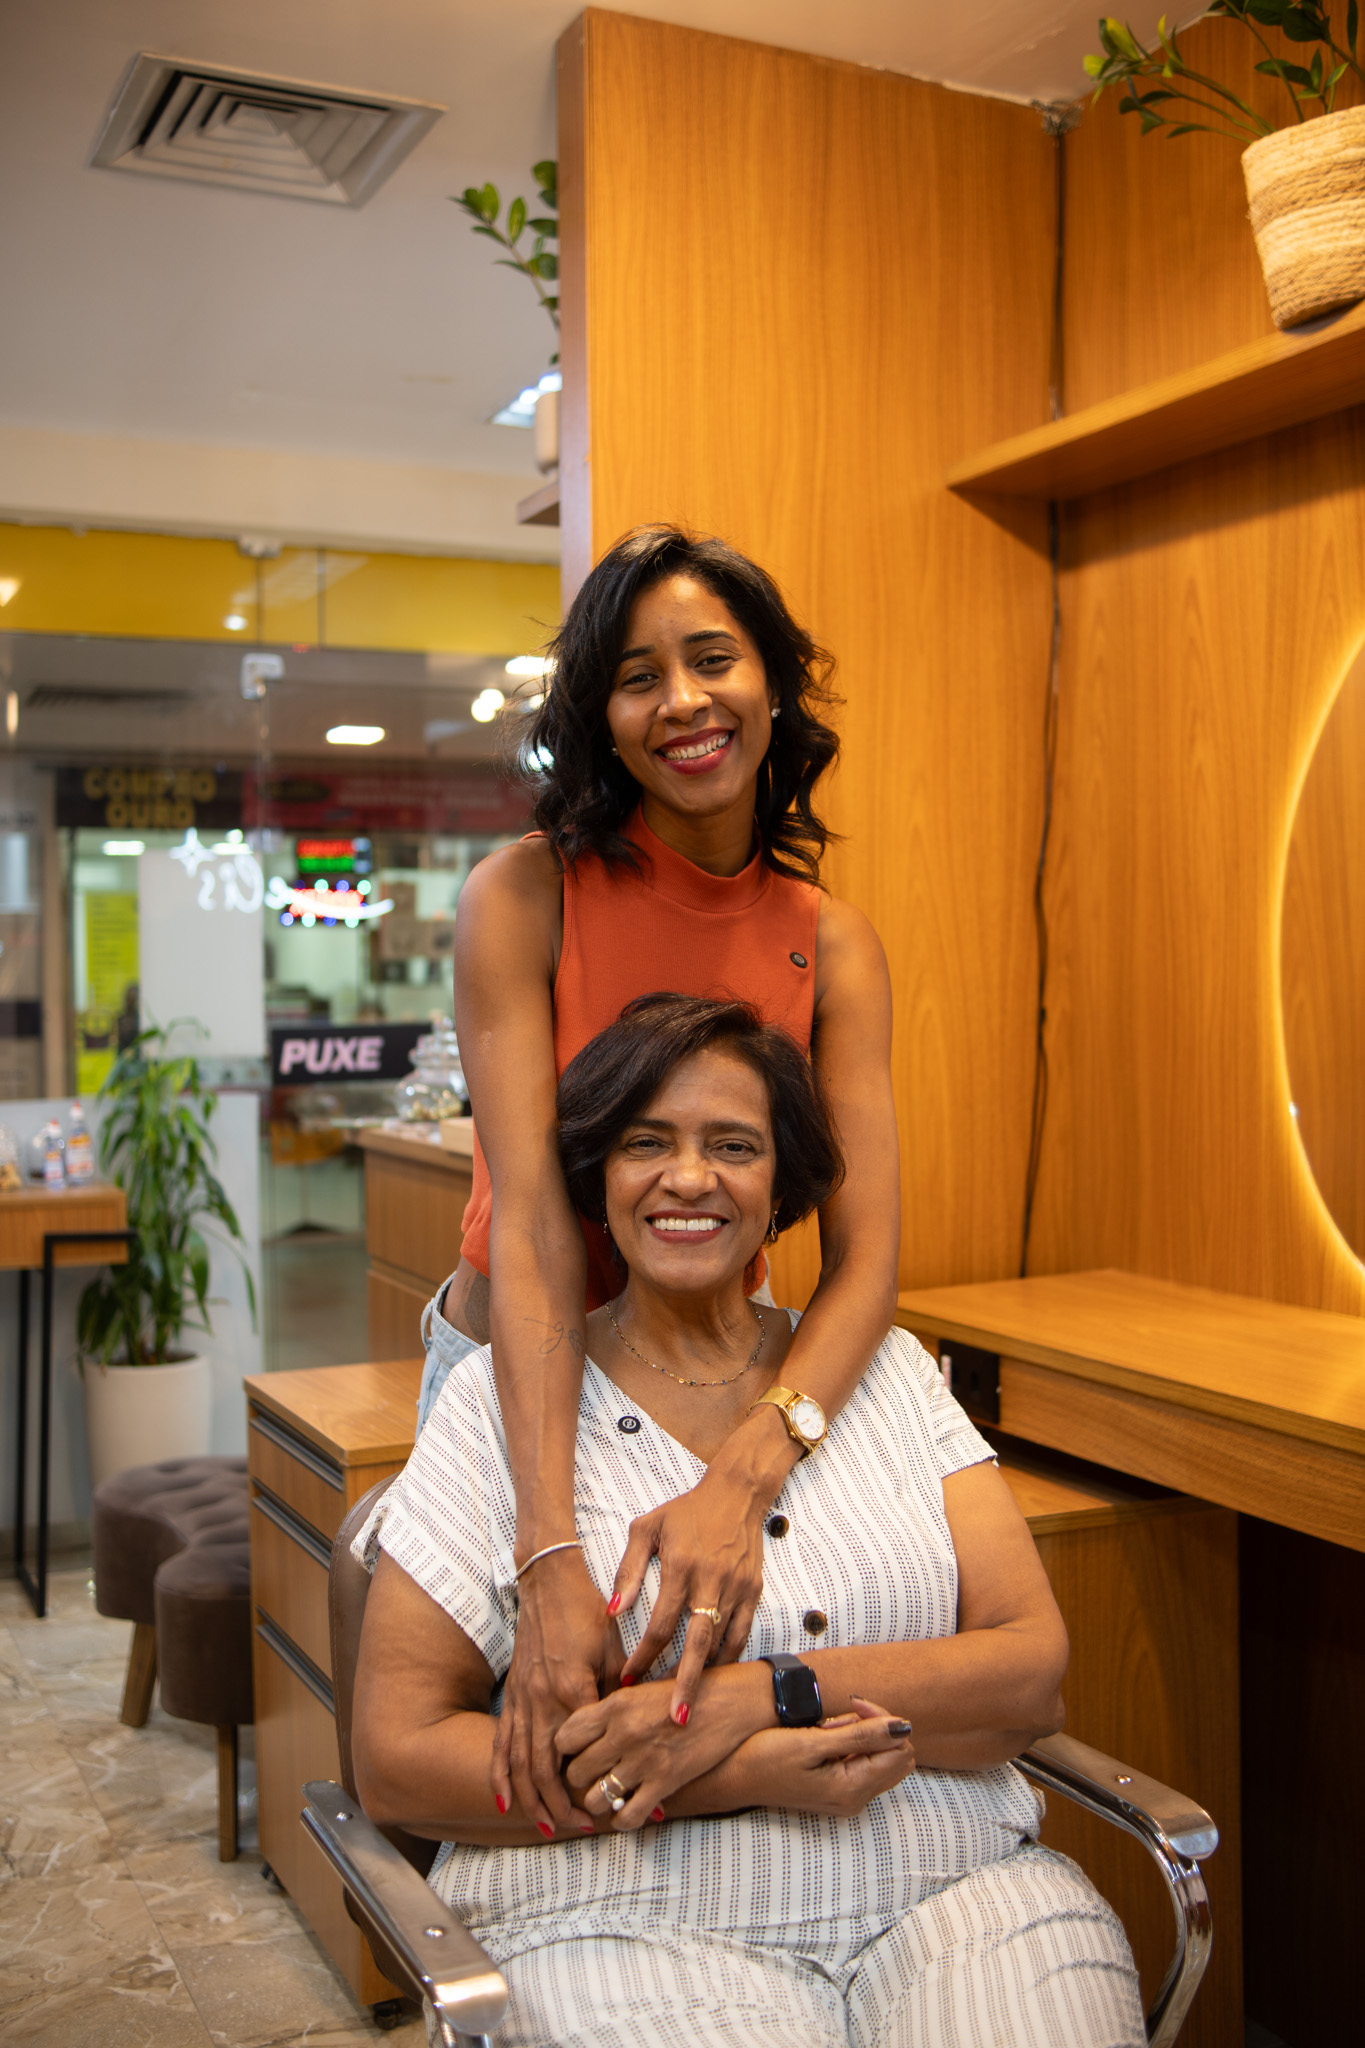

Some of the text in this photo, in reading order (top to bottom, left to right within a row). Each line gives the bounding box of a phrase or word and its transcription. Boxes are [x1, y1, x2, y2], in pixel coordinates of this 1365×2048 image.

[83, 768, 216, 802] COMPRO
[106, 799, 195, 829] OURO
[280, 1036, 383, 1074] PUXE
